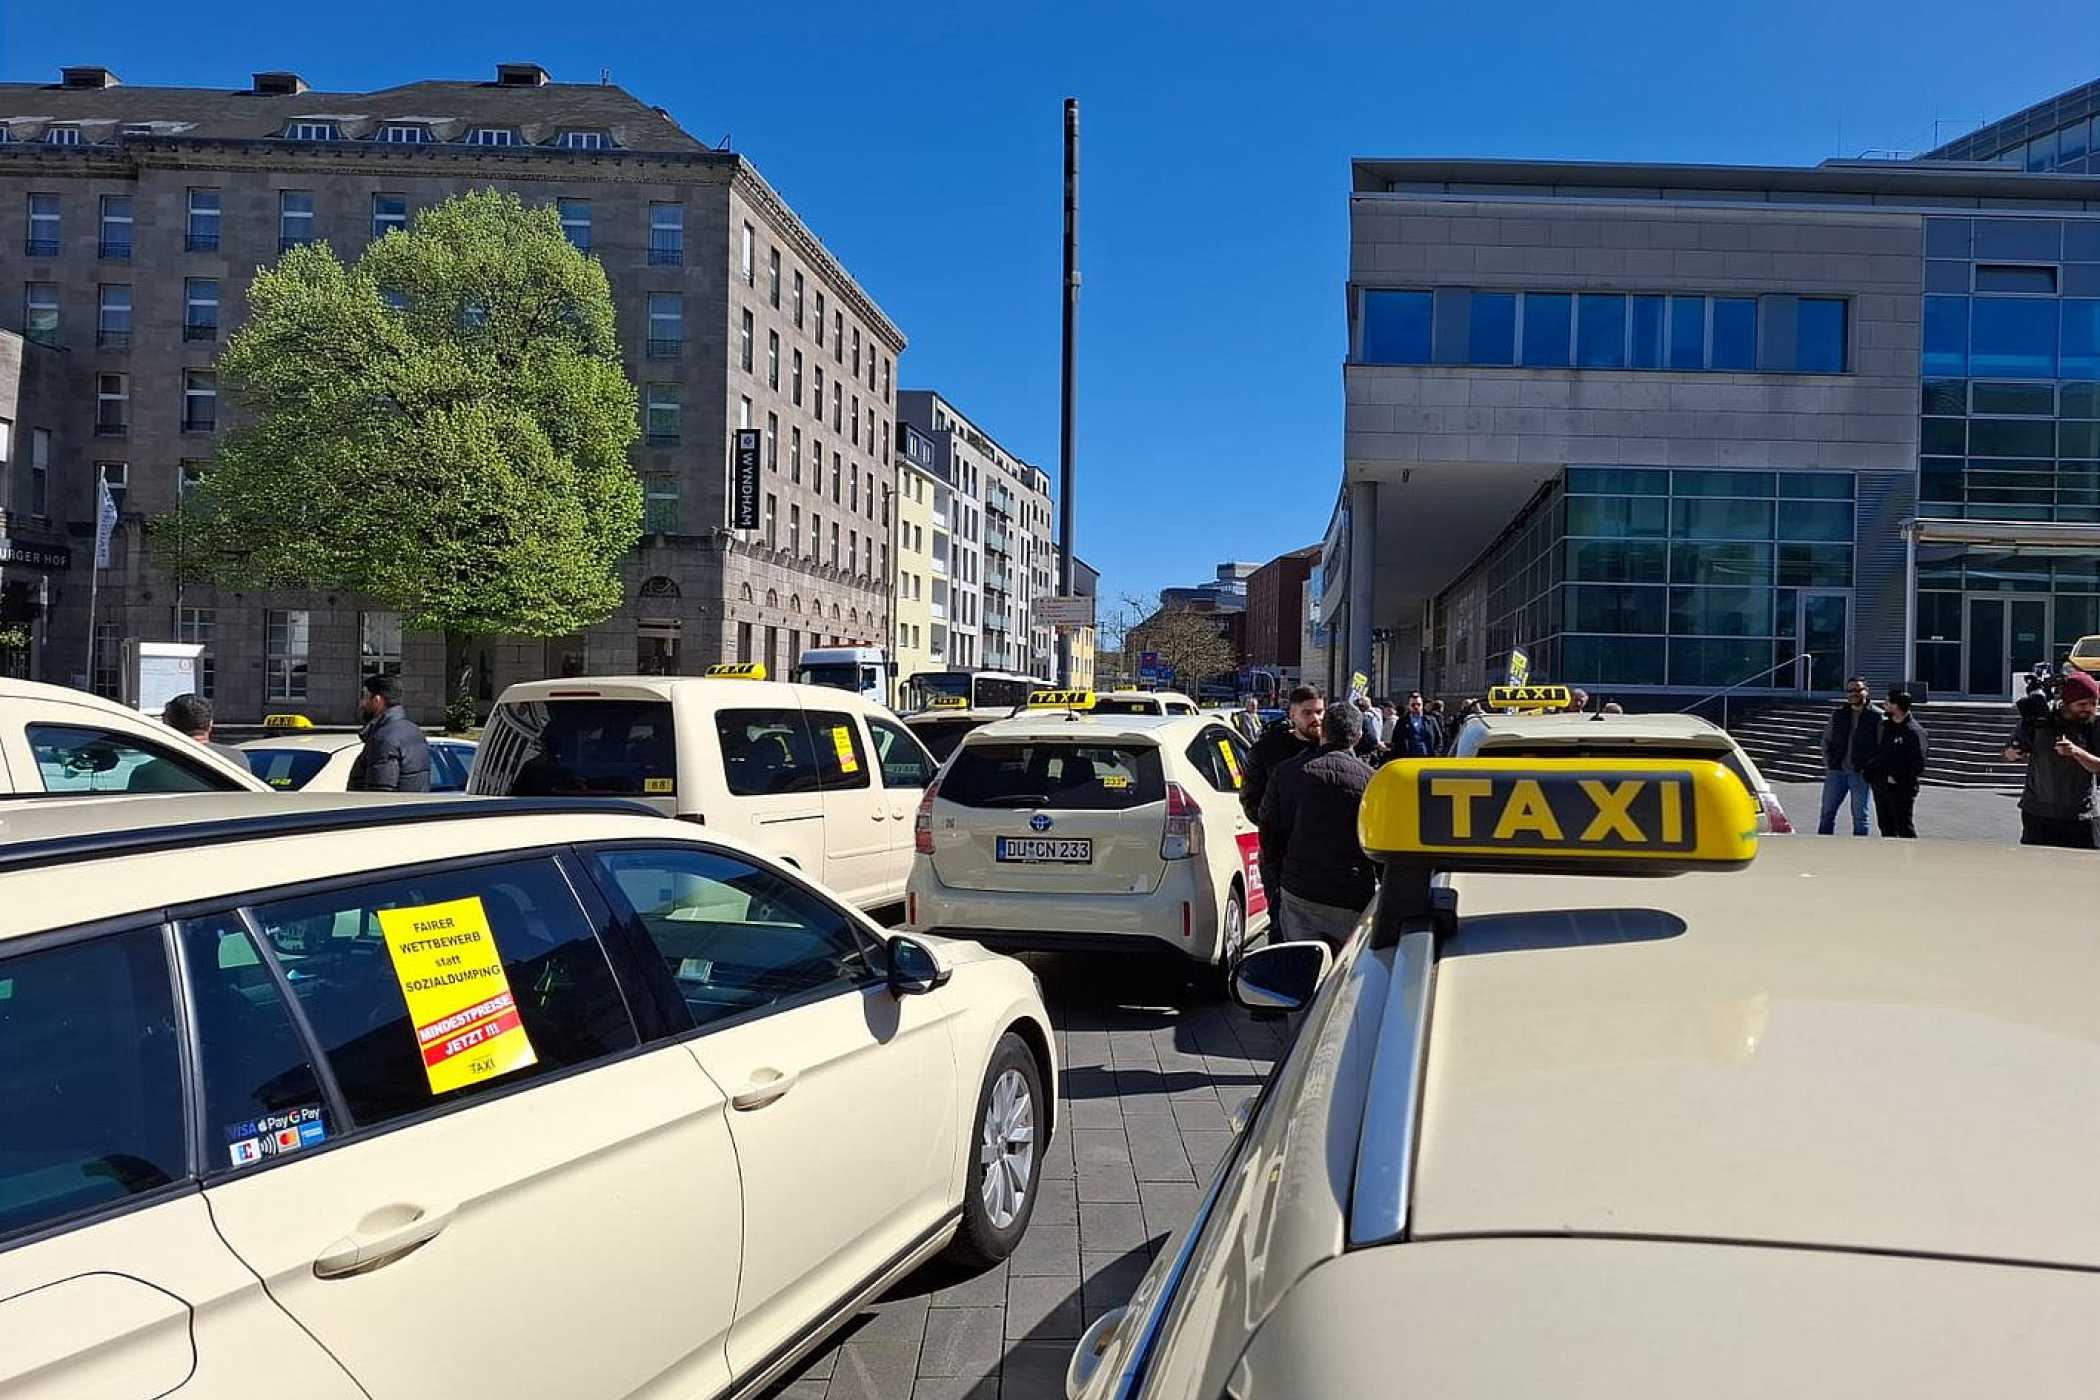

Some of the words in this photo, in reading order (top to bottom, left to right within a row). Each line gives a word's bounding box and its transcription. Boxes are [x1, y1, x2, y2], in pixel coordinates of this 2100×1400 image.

[741, 452, 753, 525] WYNDHAM
[44, 554, 67, 566] HOF
[713, 665, 748, 673] TAXI
[1037, 693, 1084, 704] TAXI
[1502, 688, 1557, 699] TAXI
[268, 716, 294, 726] TAXI
[1431, 779, 1683, 843] TAXI
[1008, 841, 1026, 857] DU
[1037, 842, 1056, 858] CN
[1060, 842, 1089, 858] 233
[413, 918, 456, 933] FAIRER
[399, 931, 481, 954] WETTBEWERB
[435, 955, 461, 967] statt
[405, 965, 500, 992] SOZIALDUMPING
[445, 1030, 483, 1055] JETZT
[470, 1058, 496, 1074] TAXI
[227, 1122, 257, 1138] VISA
[267, 1116, 288, 1129] Pay
[300, 1108, 320, 1120] Pay
